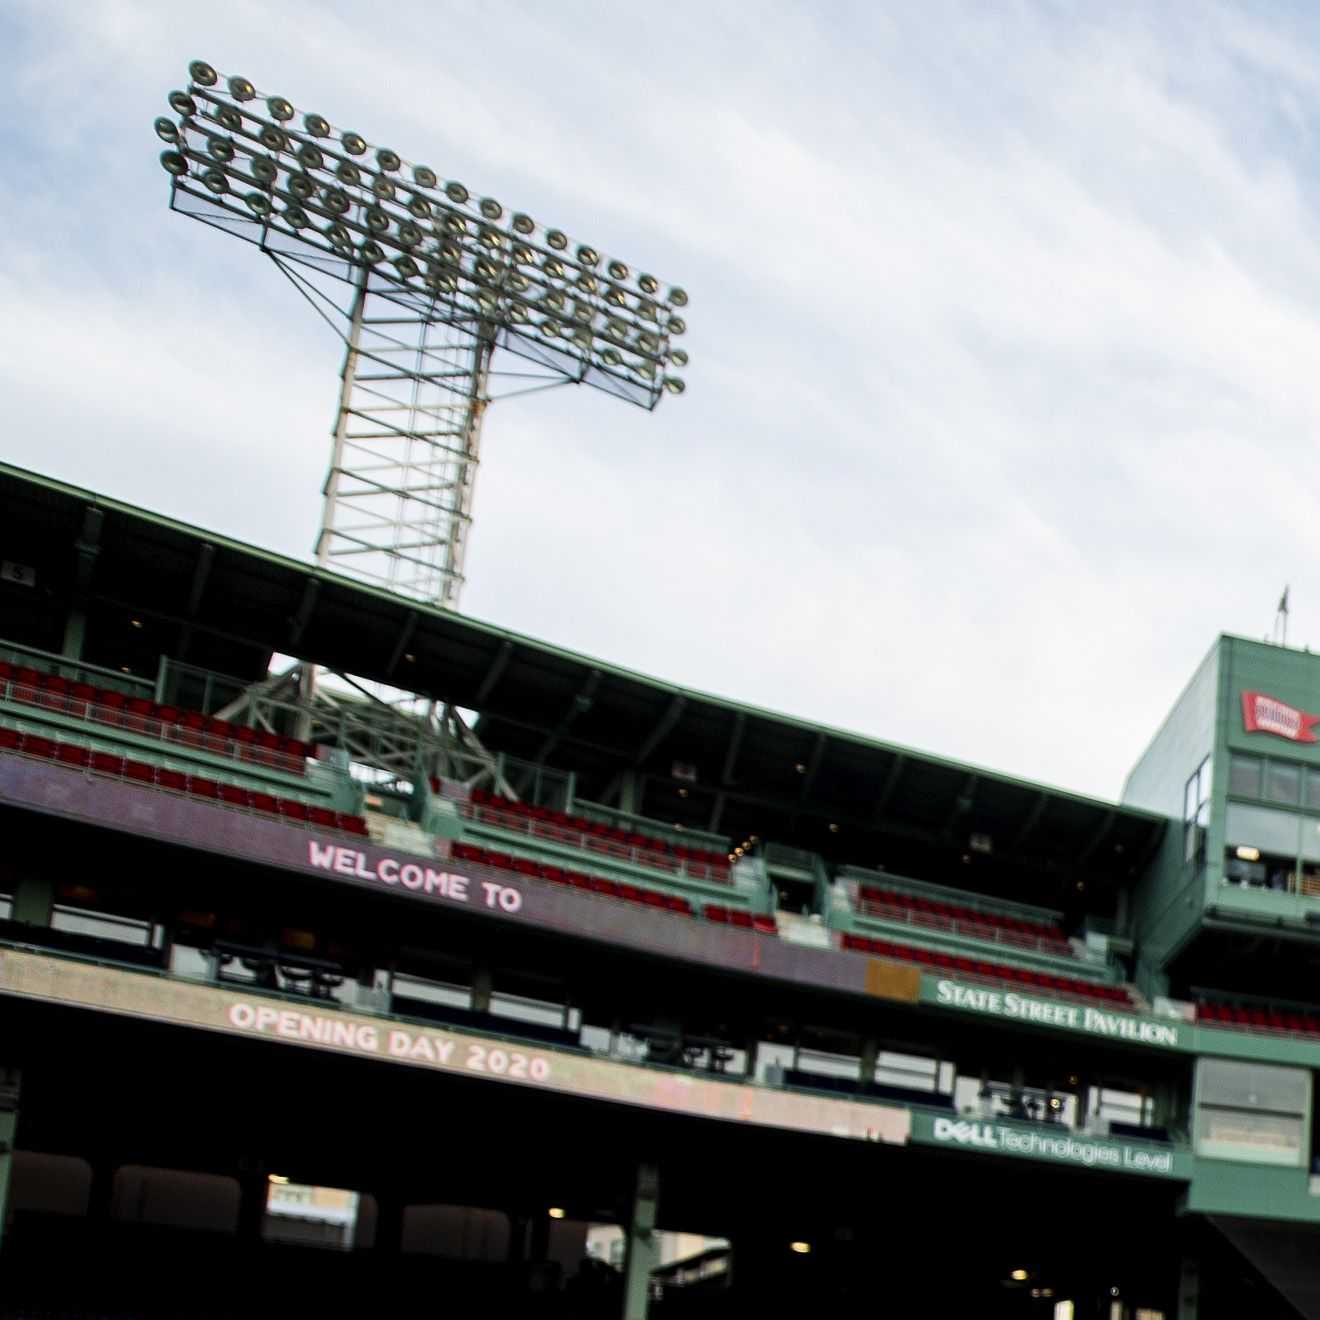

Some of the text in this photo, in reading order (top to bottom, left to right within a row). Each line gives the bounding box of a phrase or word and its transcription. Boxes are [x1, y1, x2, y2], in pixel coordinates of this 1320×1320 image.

[308, 840, 522, 913] WELCOME TO
[229, 1002, 550, 1082] OPENING DAY 2020
[937, 980, 1178, 1047] STATE STREET PAVILION
[998, 1124, 1120, 1166] Technologies
[1123, 1146, 1173, 1172] Level
